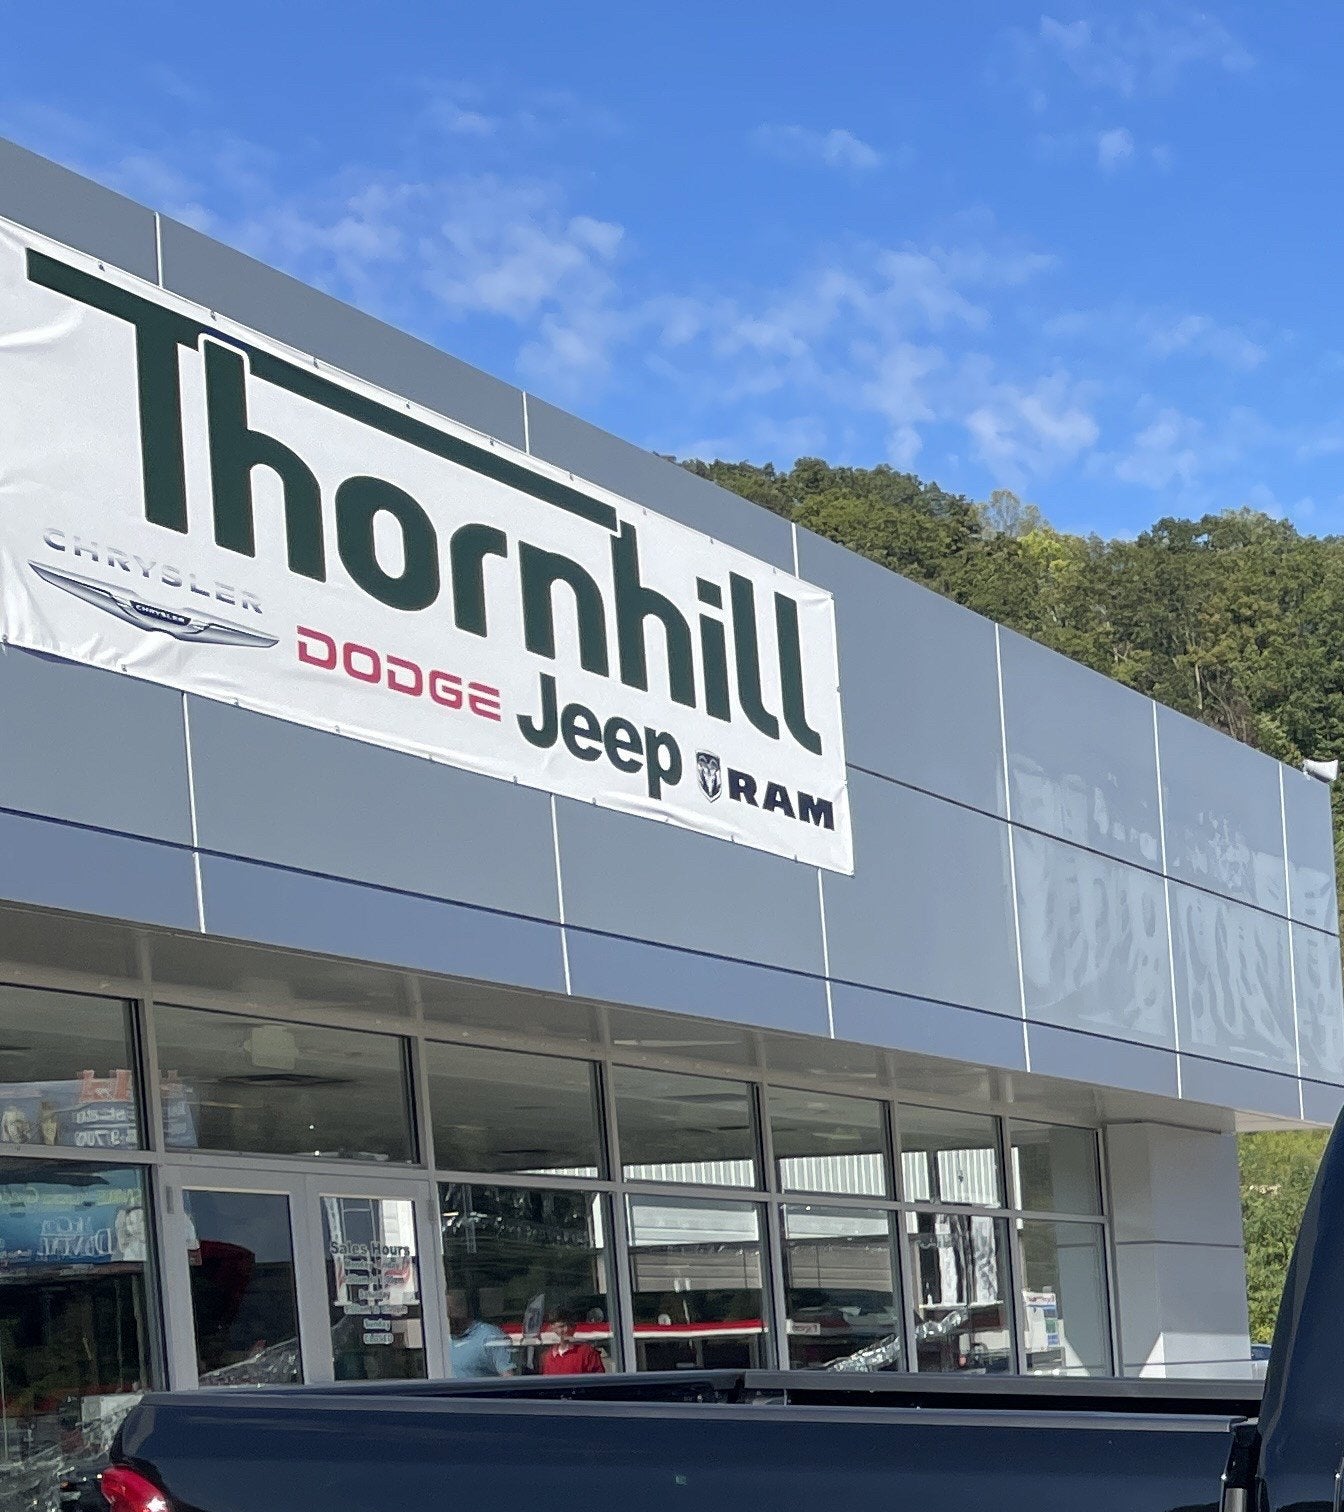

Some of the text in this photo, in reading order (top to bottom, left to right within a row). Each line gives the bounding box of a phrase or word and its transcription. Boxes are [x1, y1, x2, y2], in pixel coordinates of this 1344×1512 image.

[26, 248, 822, 756] Thornhill
[43, 527, 263, 614] CHRYSLER
[297, 625, 501, 722] DODGE
[517, 672, 683, 800] Jeep
[729, 768, 835, 831] RAM
[330, 1241, 411, 1256] Sales Hours
